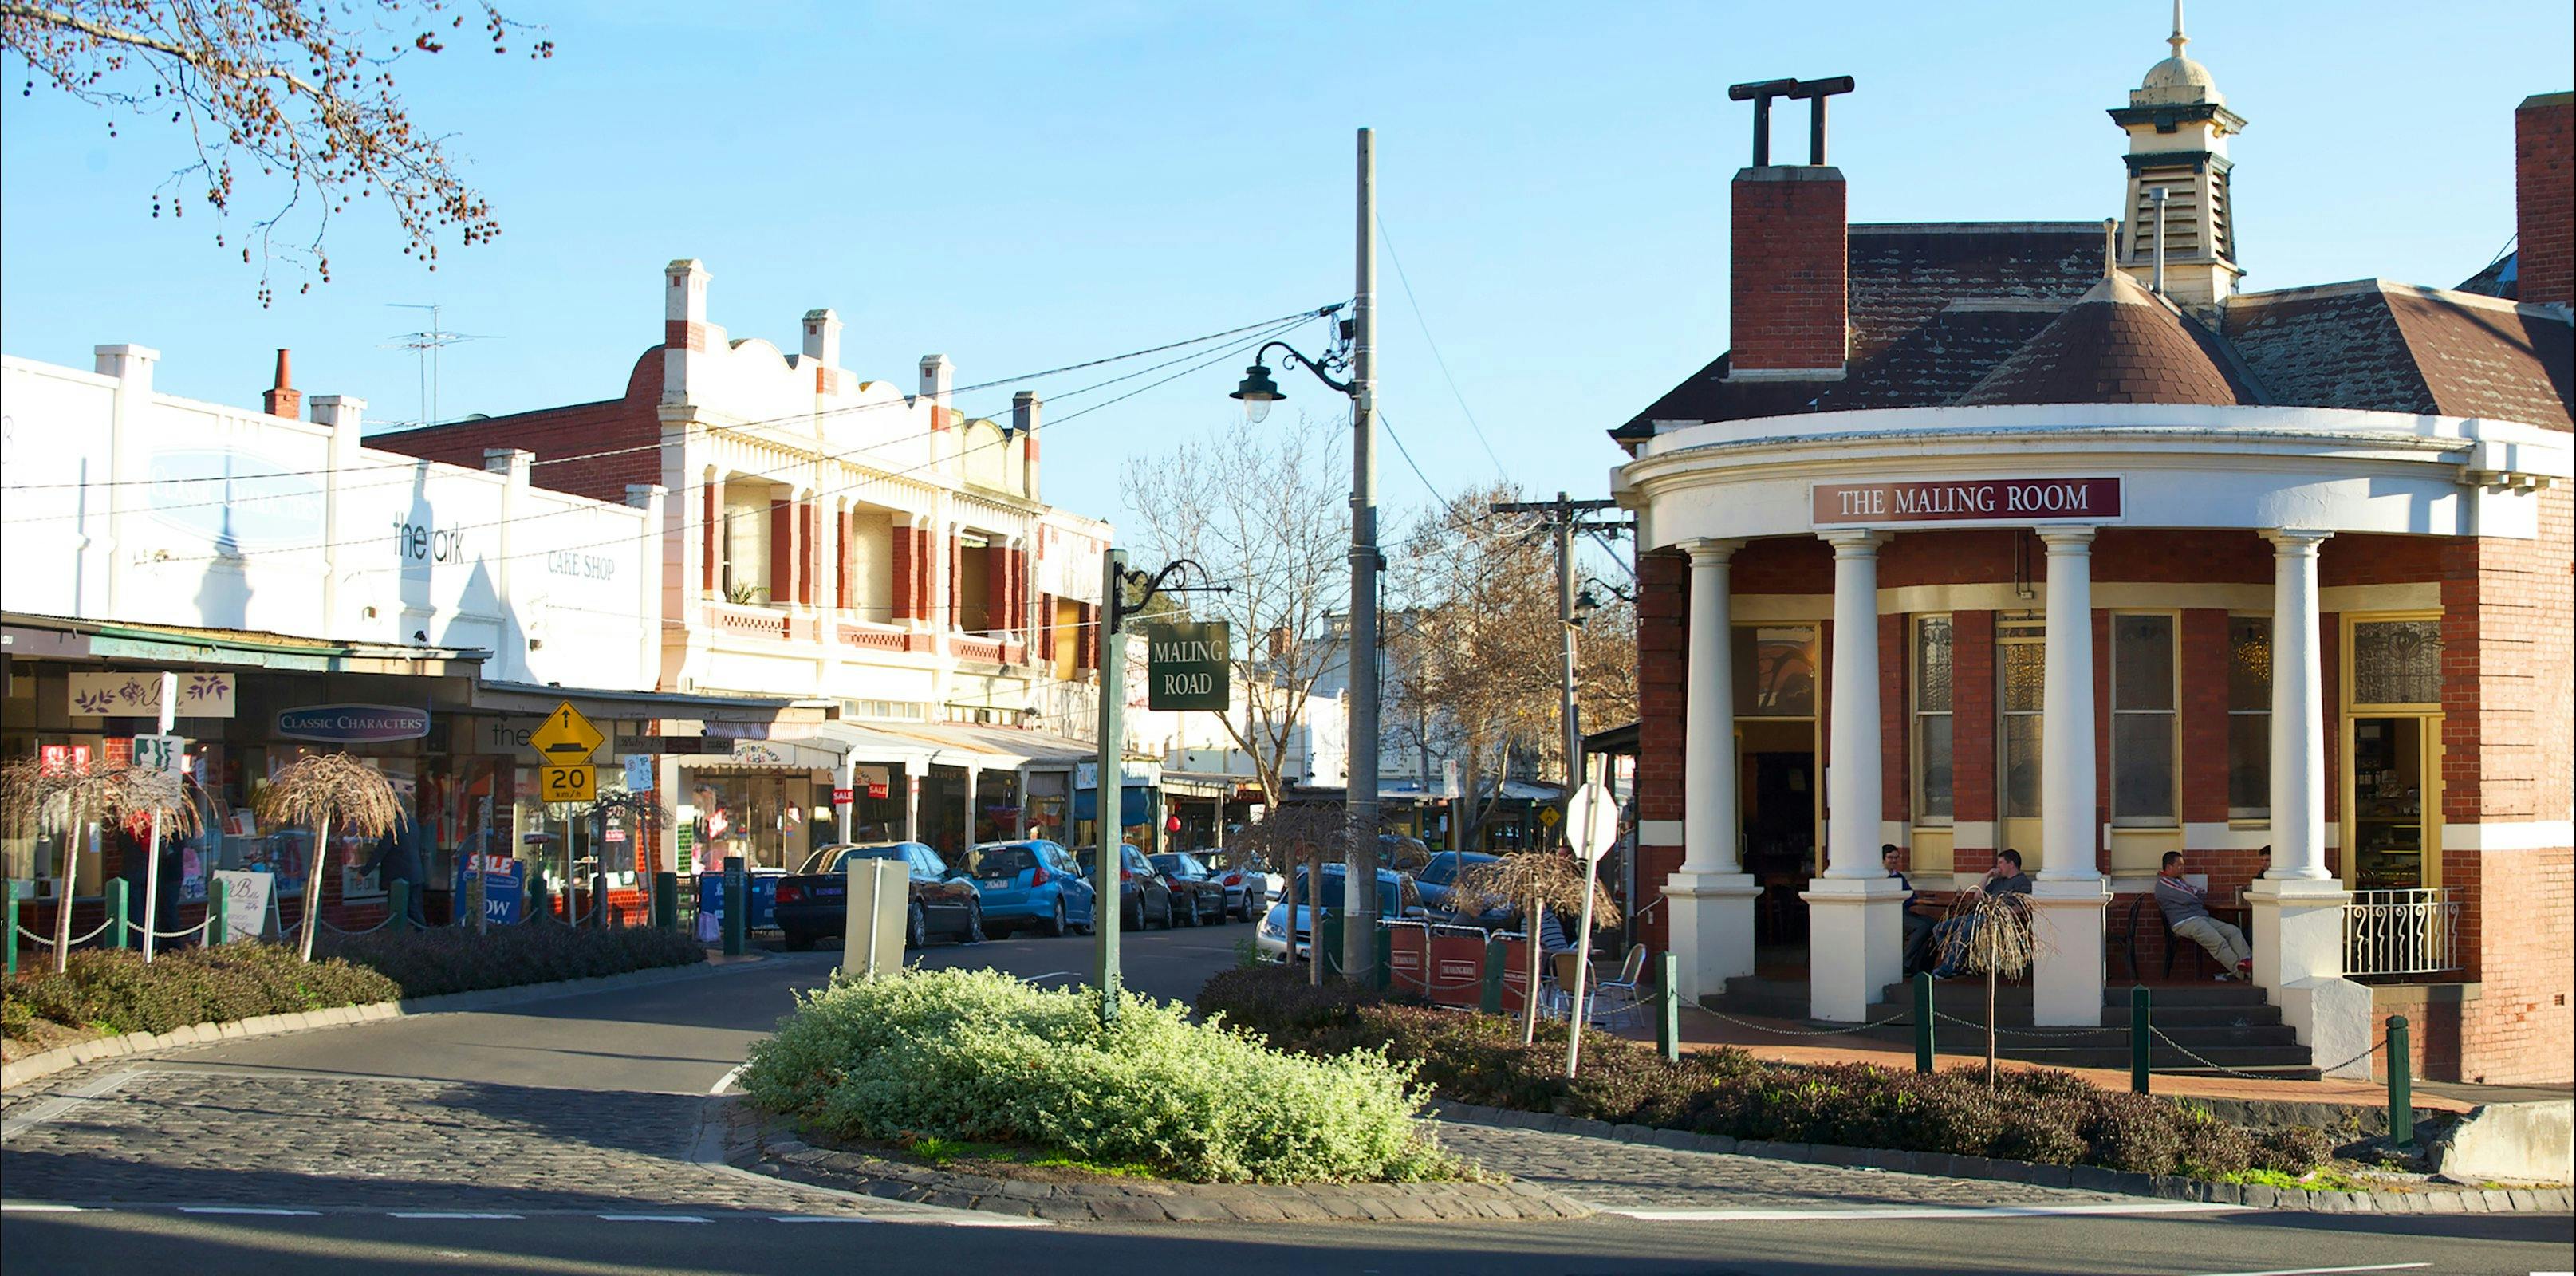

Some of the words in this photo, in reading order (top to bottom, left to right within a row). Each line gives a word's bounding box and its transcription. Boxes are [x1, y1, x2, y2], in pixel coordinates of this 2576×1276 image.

[1838, 489, 1885, 515] THE
[1894, 486, 1995, 514] MALING
[2007, 485, 2088, 511] ROOM
[393, 511, 427, 559] the
[433, 522, 464, 564] ark
[548, 550, 580, 577] CAKE
[583, 555, 615, 581] SHOP
[1154, 640, 1223, 663] MALING
[1164, 673, 1212, 695] ROAD
[281, 715, 333, 729] CLASSIC
[337, 715, 423, 730] CHARACTERS
[492, 723, 530, 746] the
[729, 744, 781, 762] Canterbury
[551, 769, 585, 788] 20
[833, 791, 853, 800] SALE
[869, 785, 887, 794] SALE
[485, 899, 510, 916] OW
